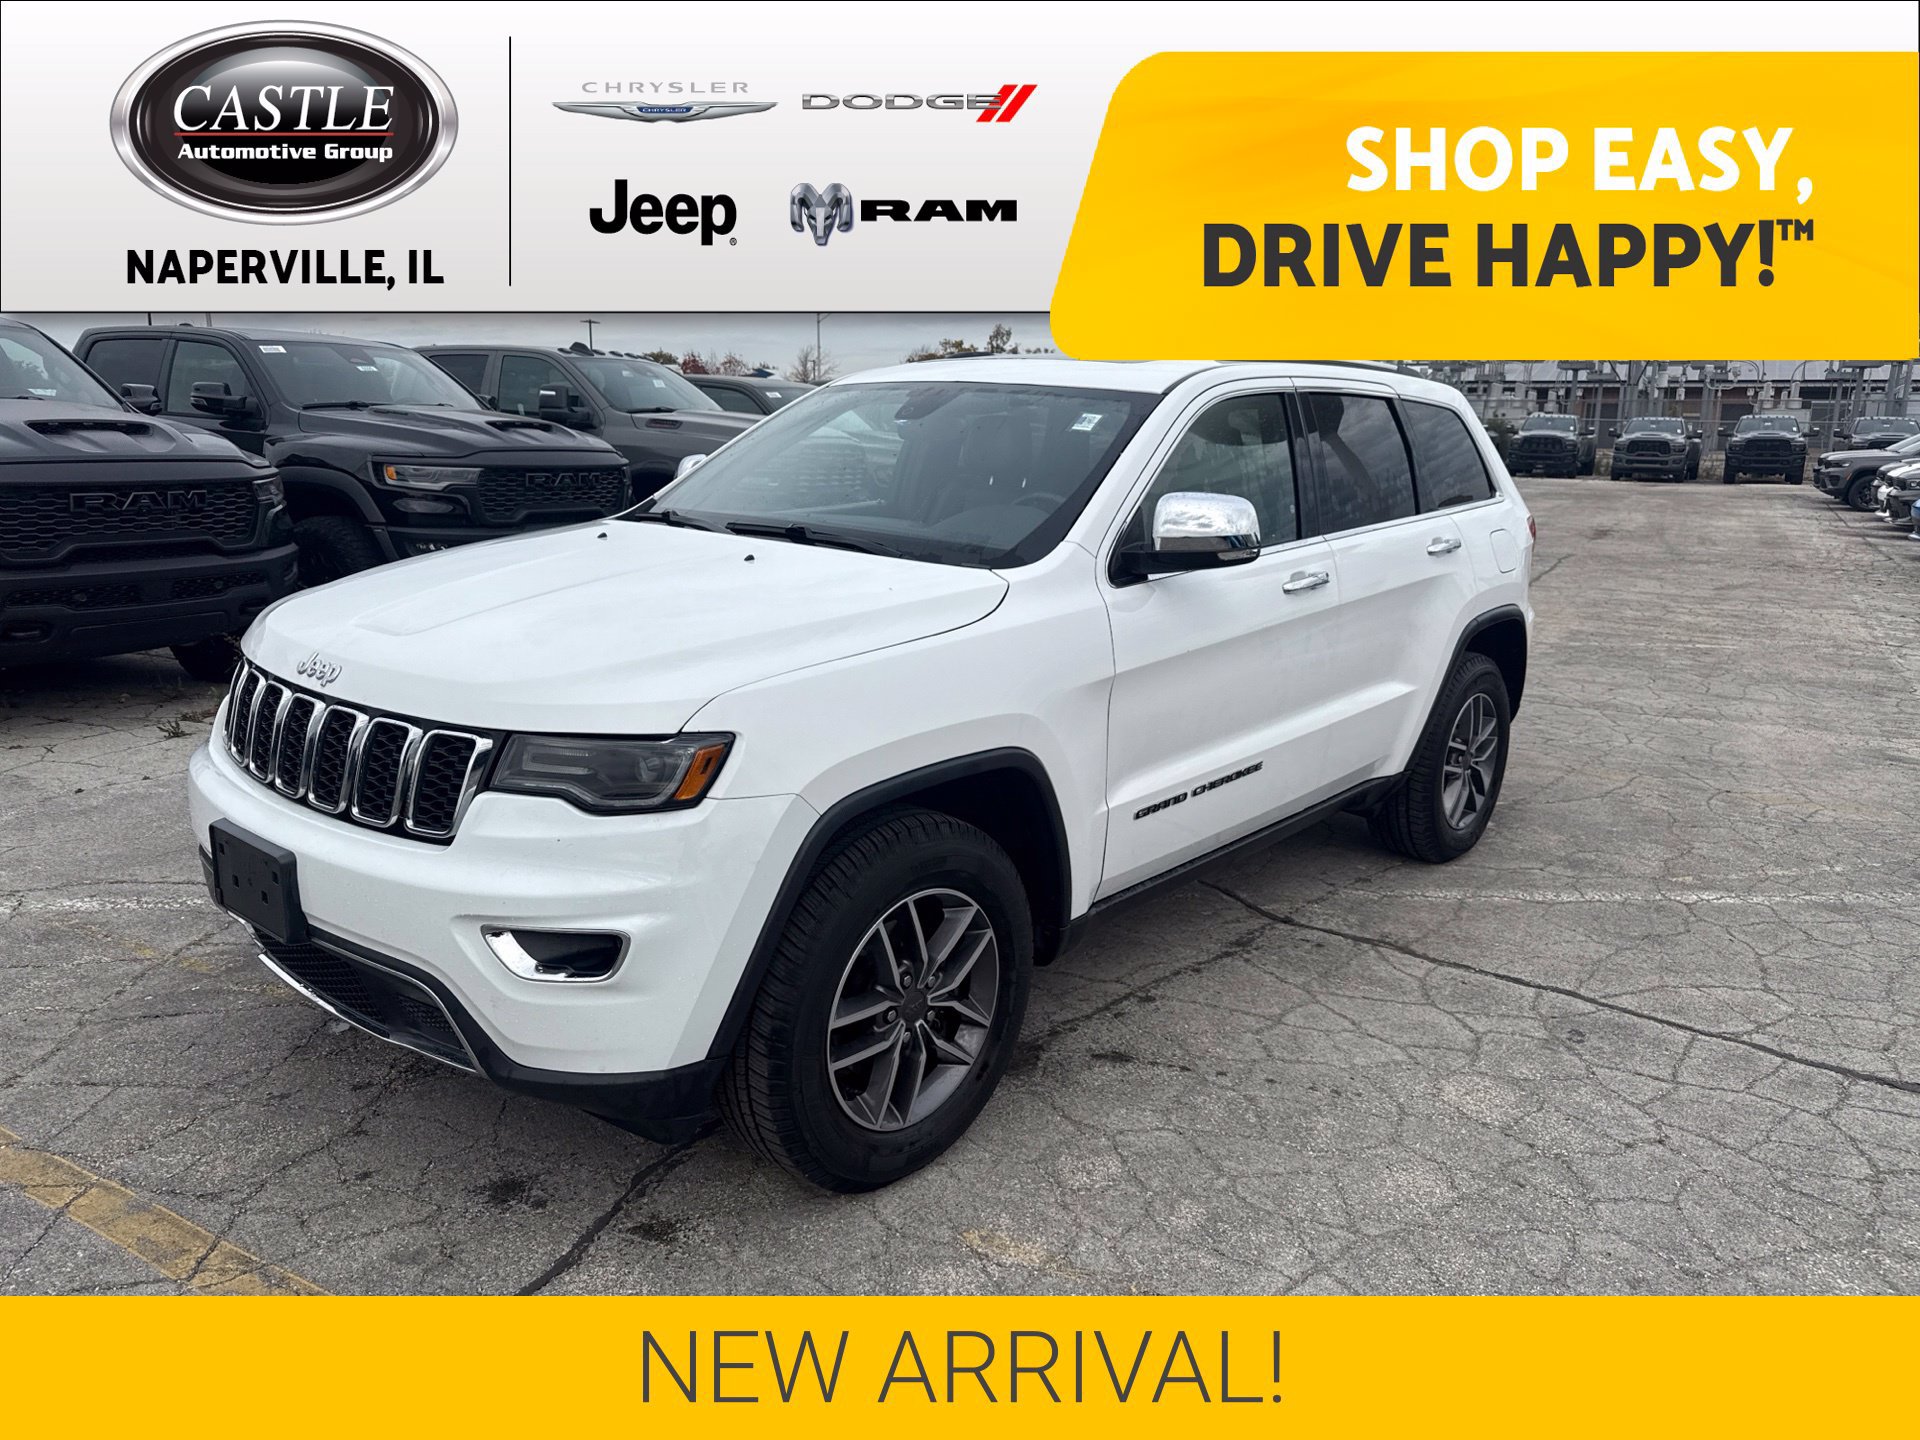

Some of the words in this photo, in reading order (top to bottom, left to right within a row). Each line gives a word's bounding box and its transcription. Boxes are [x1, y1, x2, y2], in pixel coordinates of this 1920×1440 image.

[526, 473, 600, 488] RAM
[69, 490, 207, 512] RAM
[296, 651, 342, 687] Jeep
[1133, 792, 1188, 820] GRAND
[1191, 761, 1263, 797] CHEROKEE
